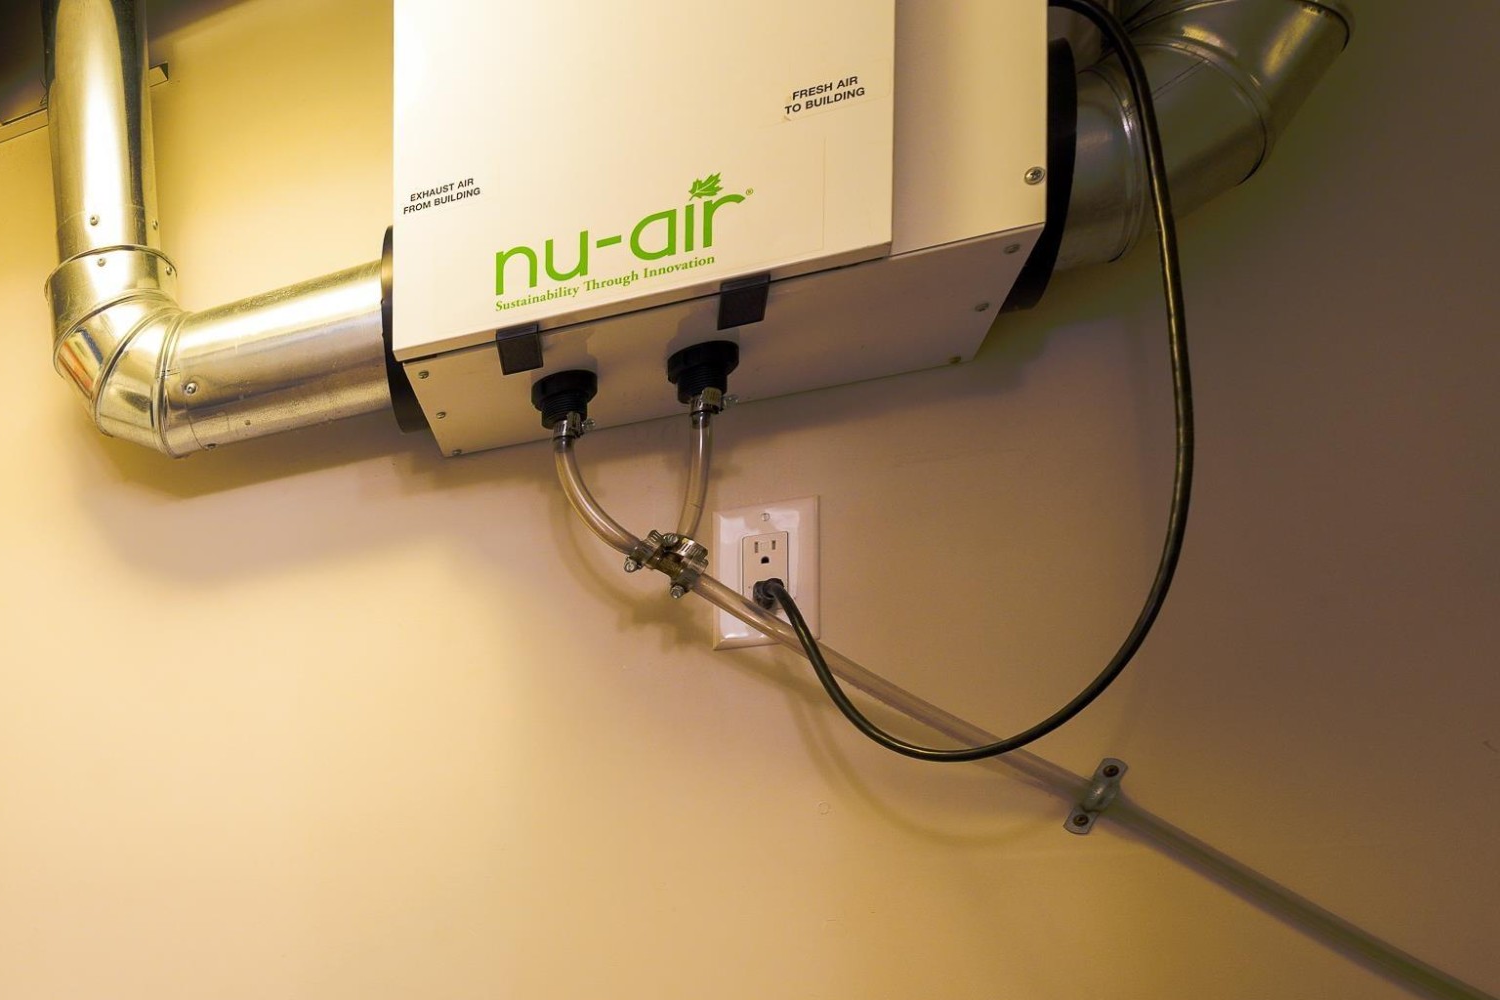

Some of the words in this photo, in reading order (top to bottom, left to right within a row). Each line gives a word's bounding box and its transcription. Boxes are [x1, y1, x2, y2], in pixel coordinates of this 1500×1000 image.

[784, 103, 802, 115] TO
[805, 87, 865, 110] BUILDING
[792, 82, 833, 101] FRESH
[836, 76, 858, 89] AIR
[403, 200, 431, 215] FROM
[434, 187, 481, 206] BUILDING
[410, 183, 455, 202] EXHAUST
[457, 178, 474, 189] AIR
[495, 281, 580, 312] Sustainability
[583, 270, 639, 293] Through
[643, 255, 715, 279] Innovation
